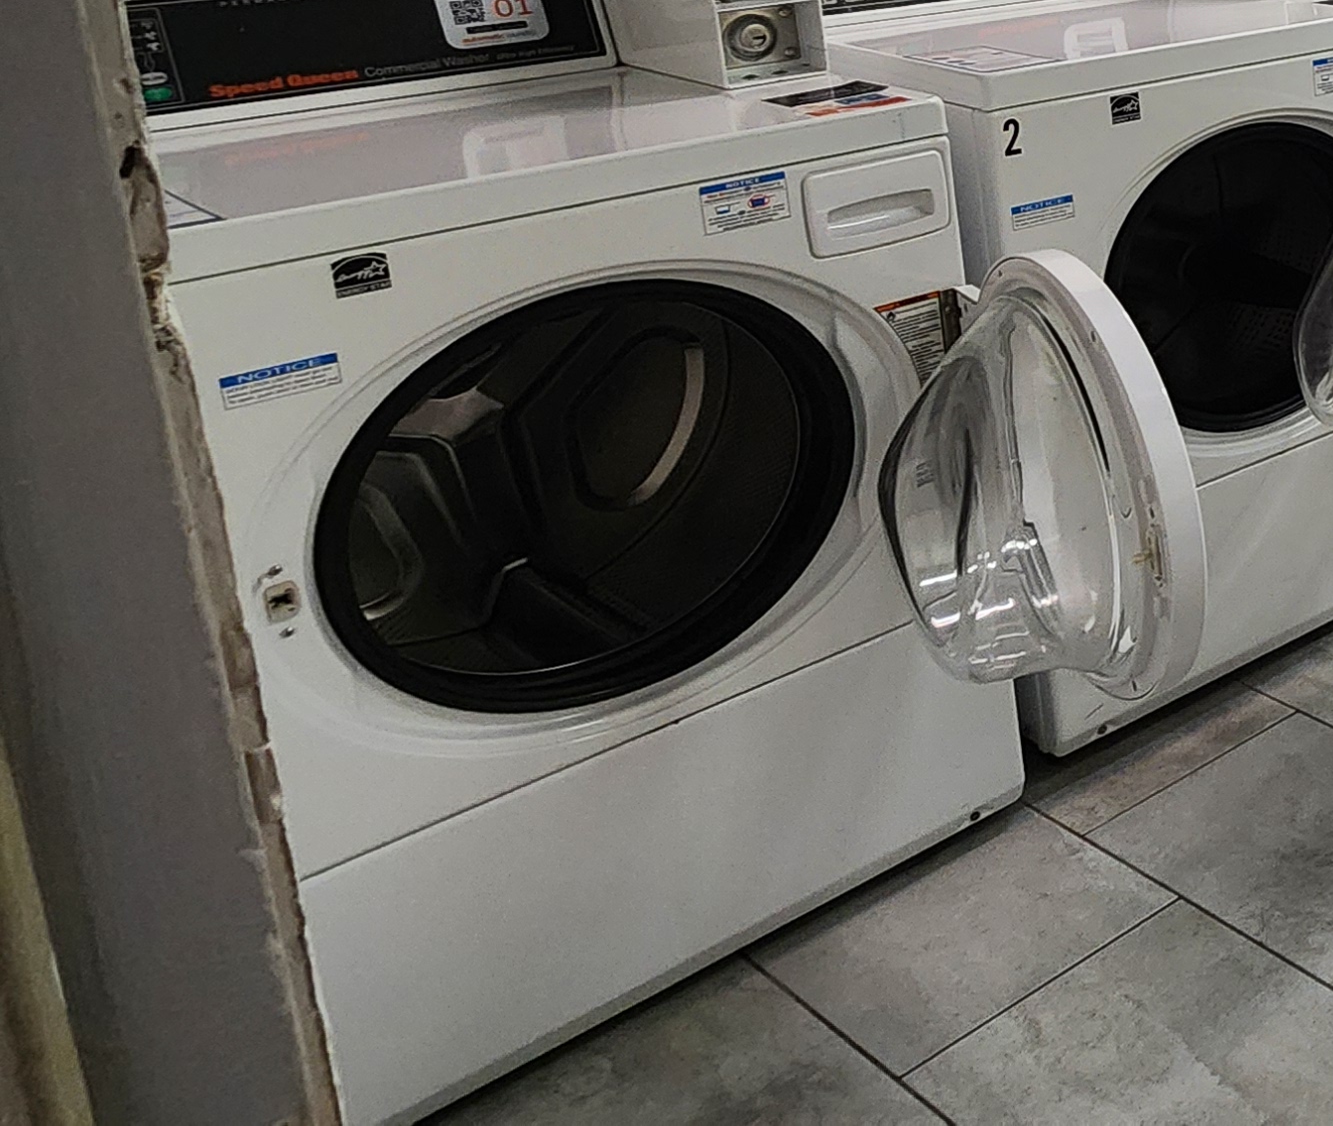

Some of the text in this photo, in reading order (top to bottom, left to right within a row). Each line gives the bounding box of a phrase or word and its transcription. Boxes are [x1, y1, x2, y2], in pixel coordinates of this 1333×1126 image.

[209, 76, 283, 99] Speed
[286, 69, 360, 88] Queen
[364, 57, 442, 77] Commercial
[1002, 118, 1022, 157] 2
[236, 358, 321, 383] NOTICE
